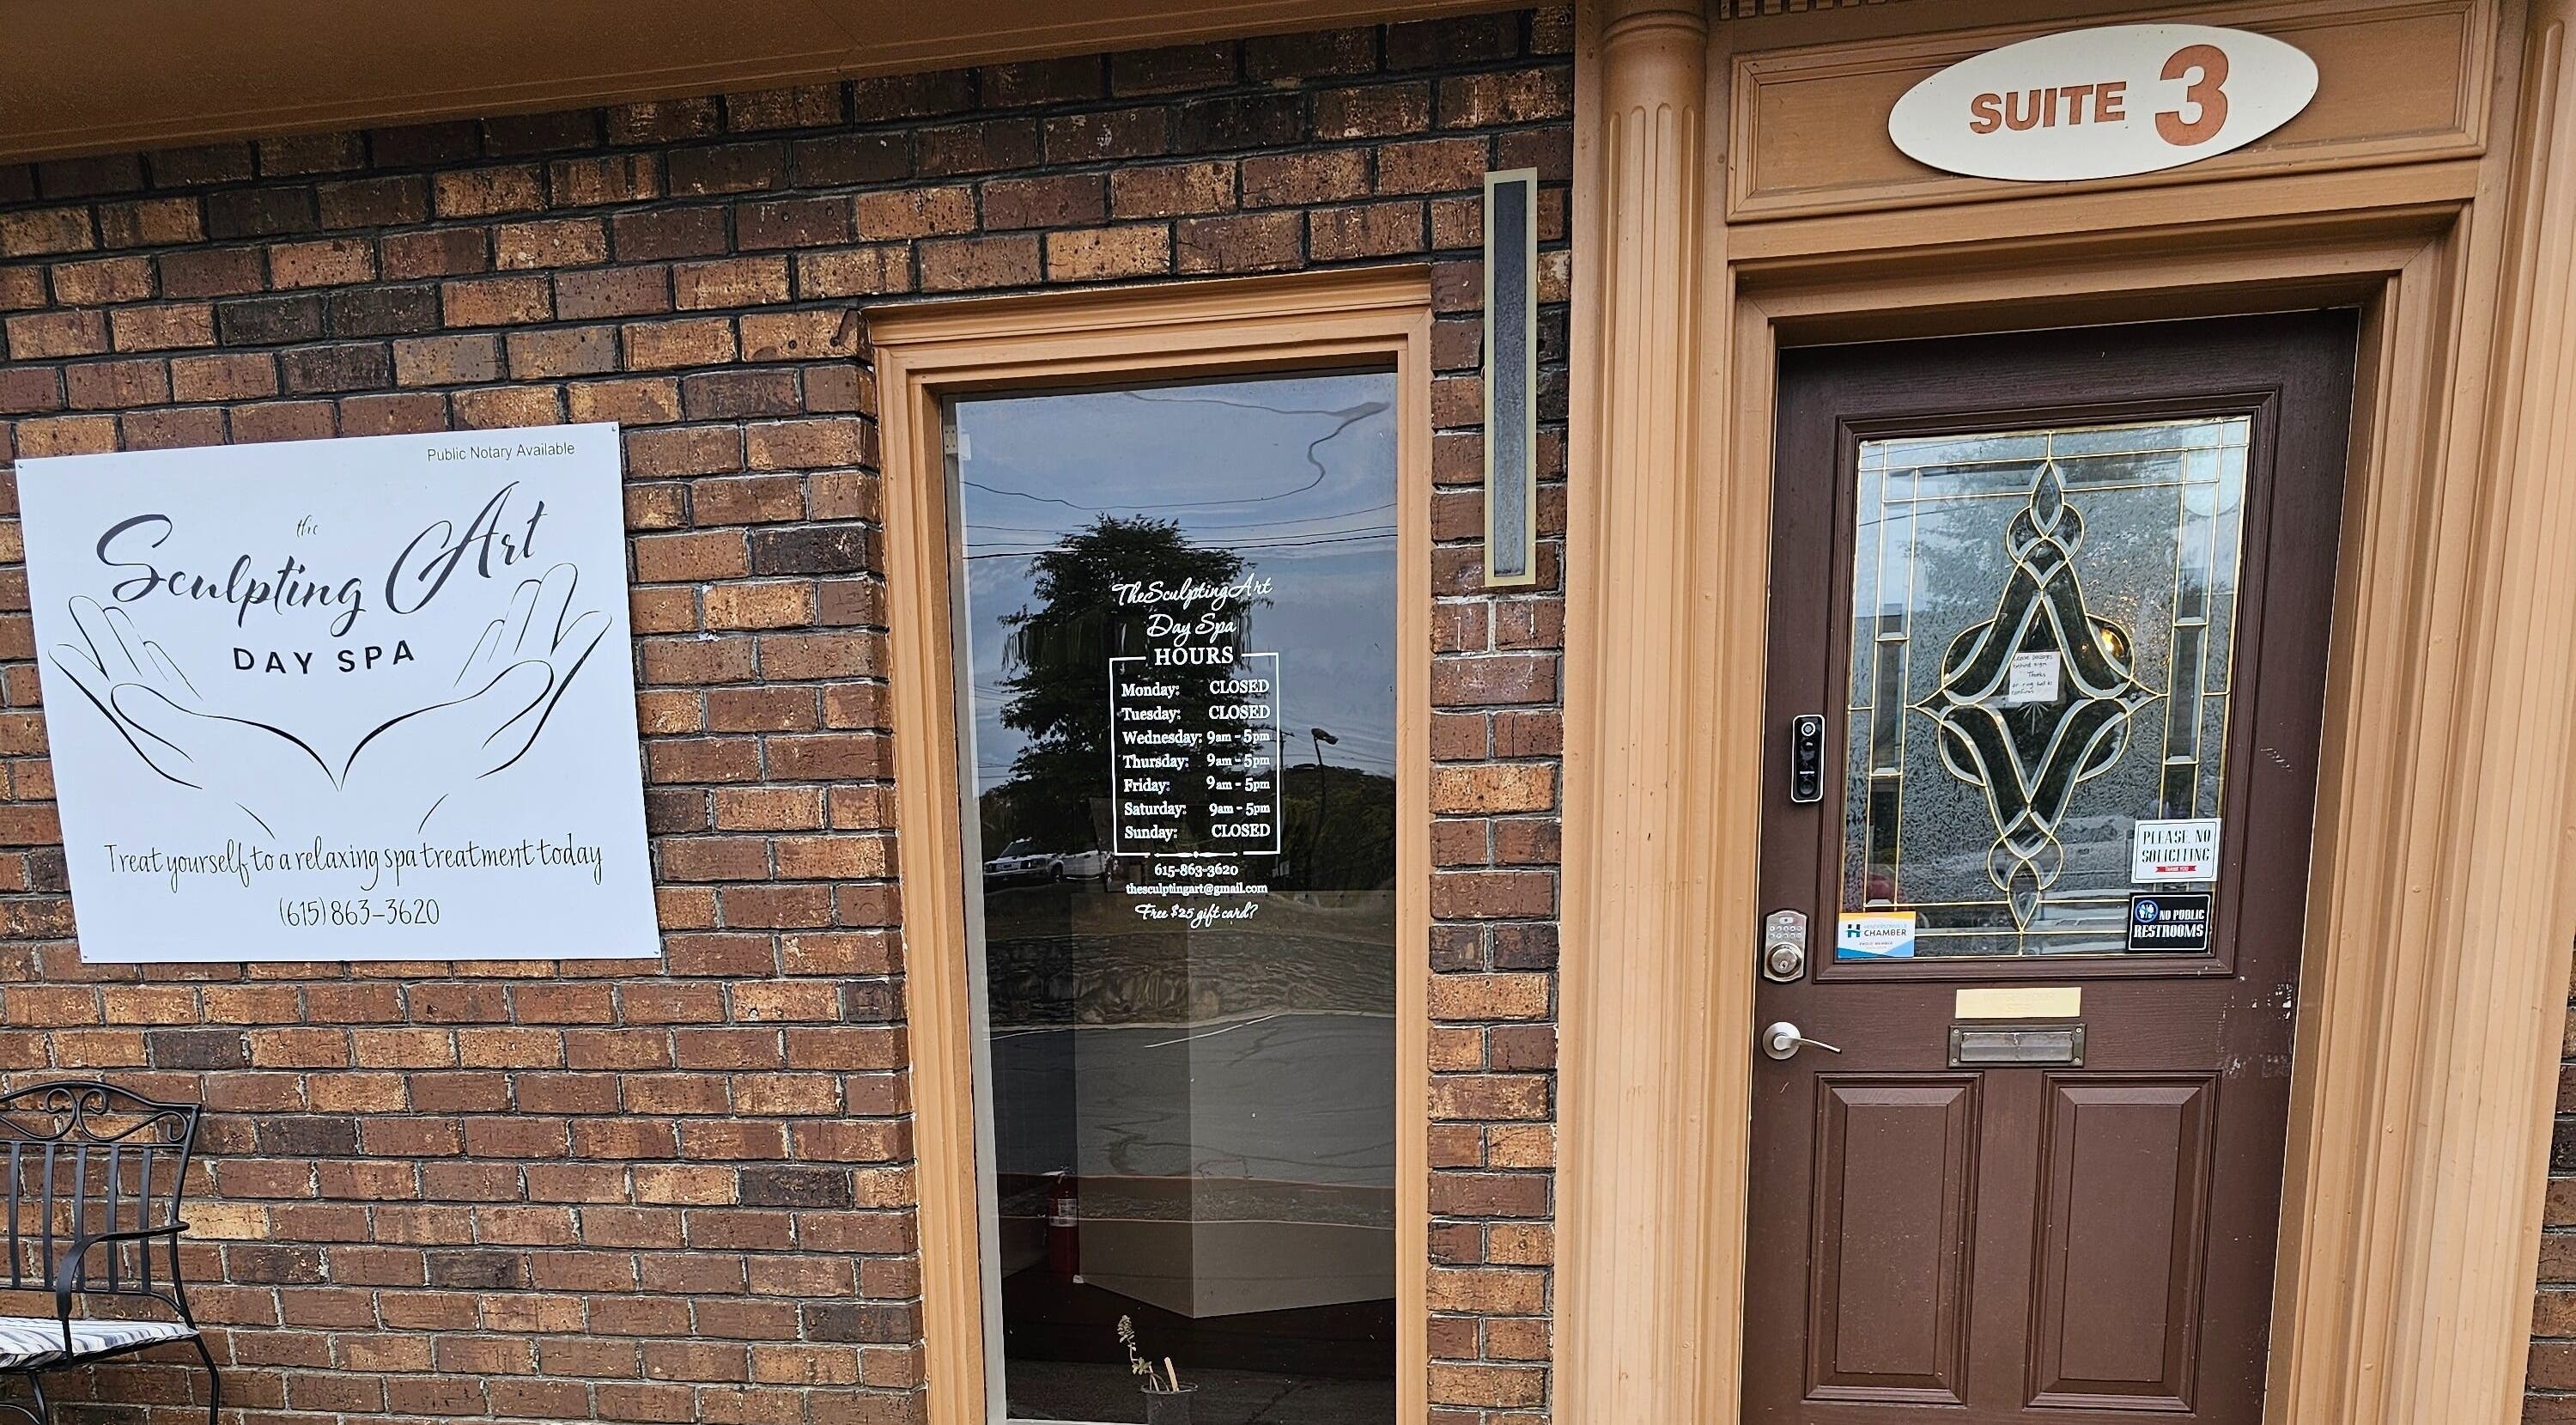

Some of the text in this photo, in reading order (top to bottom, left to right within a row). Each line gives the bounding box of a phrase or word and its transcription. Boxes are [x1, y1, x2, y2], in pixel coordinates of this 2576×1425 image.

[1970, 44, 2229, 146] SUITE 3
[428, 442, 575, 461] Public Notary Available
[297, 515, 319, 537] the
[96, 481, 549, 636] Sculpting Art
[1147, 612, 1236, 647] Day Spa
[234, 640, 415, 673] DAY SPA
[1154, 646, 1233, 666] HOURS
[1121, 679, 1270, 699] Monday: CLOSED
[1121, 705, 1271, 723] Tuesday: CLOSED
[1122, 729, 1202, 746] Wednesday:
[1206, 730, 1232, 744] 9am
[1242, 729, 1270, 744] 5pm
[1123, 754, 1188, 770] Thursday:
[1206, 753, 1232, 766] 9am
[1243, 754, 1270, 766] 5pm
[1123, 778, 1170, 795] Friday:
[1206, 776, 1232, 789] 9am
[1244, 778, 1270, 792] 5pm
[1124, 801, 1187, 818] Saturday:
[1209, 803, 1234, 816] 9am
[1245, 802, 1270, 814] 5pm
[1124, 824, 1271, 842] Sunday: CLOSED
[2143, 829, 2211, 845] PLEASE NO
[104, 833, 603, 893] Treat yourself to a relaxing spa treatment today
[2142, 848, 2210, 863] SOLICITING
[1154, 863, 1238, 877] 615-863-3620
[1126, 883, 1268, 897] thesculptingart@gmail.com
[1135, 903, 1168, 920] Free
[1170, 904, 1194, 919] $25
[1190, 903, 1220, 929] gift
[2159, 909, 2205, 921] NO PUBLIC
[2133, 924, 2204, 938] RESTROOMS
